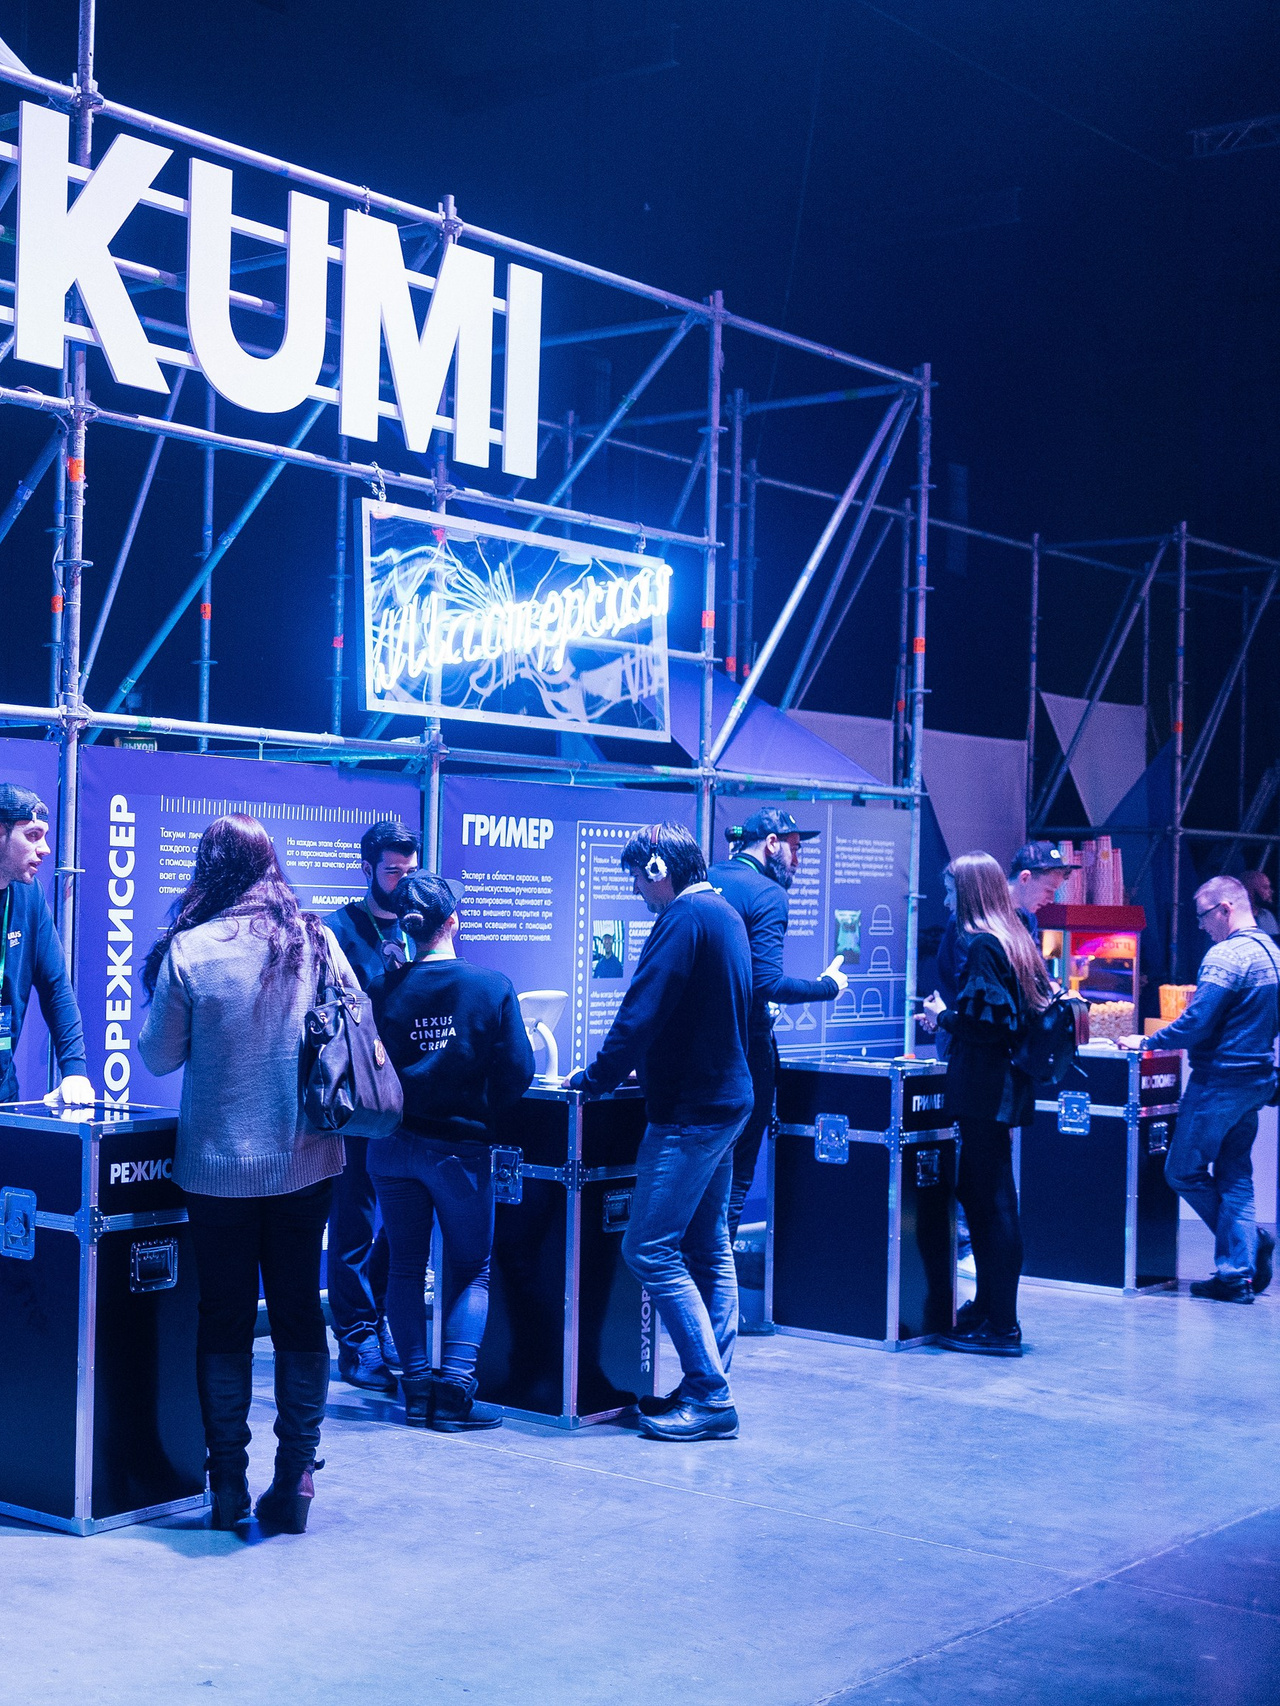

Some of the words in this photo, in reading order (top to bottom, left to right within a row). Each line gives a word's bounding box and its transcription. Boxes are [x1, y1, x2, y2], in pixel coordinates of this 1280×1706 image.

[160, 826, 186, 841] Такуми
[462, 813, 554, 849] ГРИМЕР
[286, 837, 296, 846] На
[160, 844, 191, 854] каждого
[160, 872, 176, 880] вает
[461, 869, 485, 882] Эксперт
[492, 870, 515, 881] области
[415, 1016, 453, 1027] LEXUS
[410, 1027, 456, 1040] CINEMA
[420, 1039, 448, 1051] CREW
[110, 1158, 172, 1185] РЕЖИС
